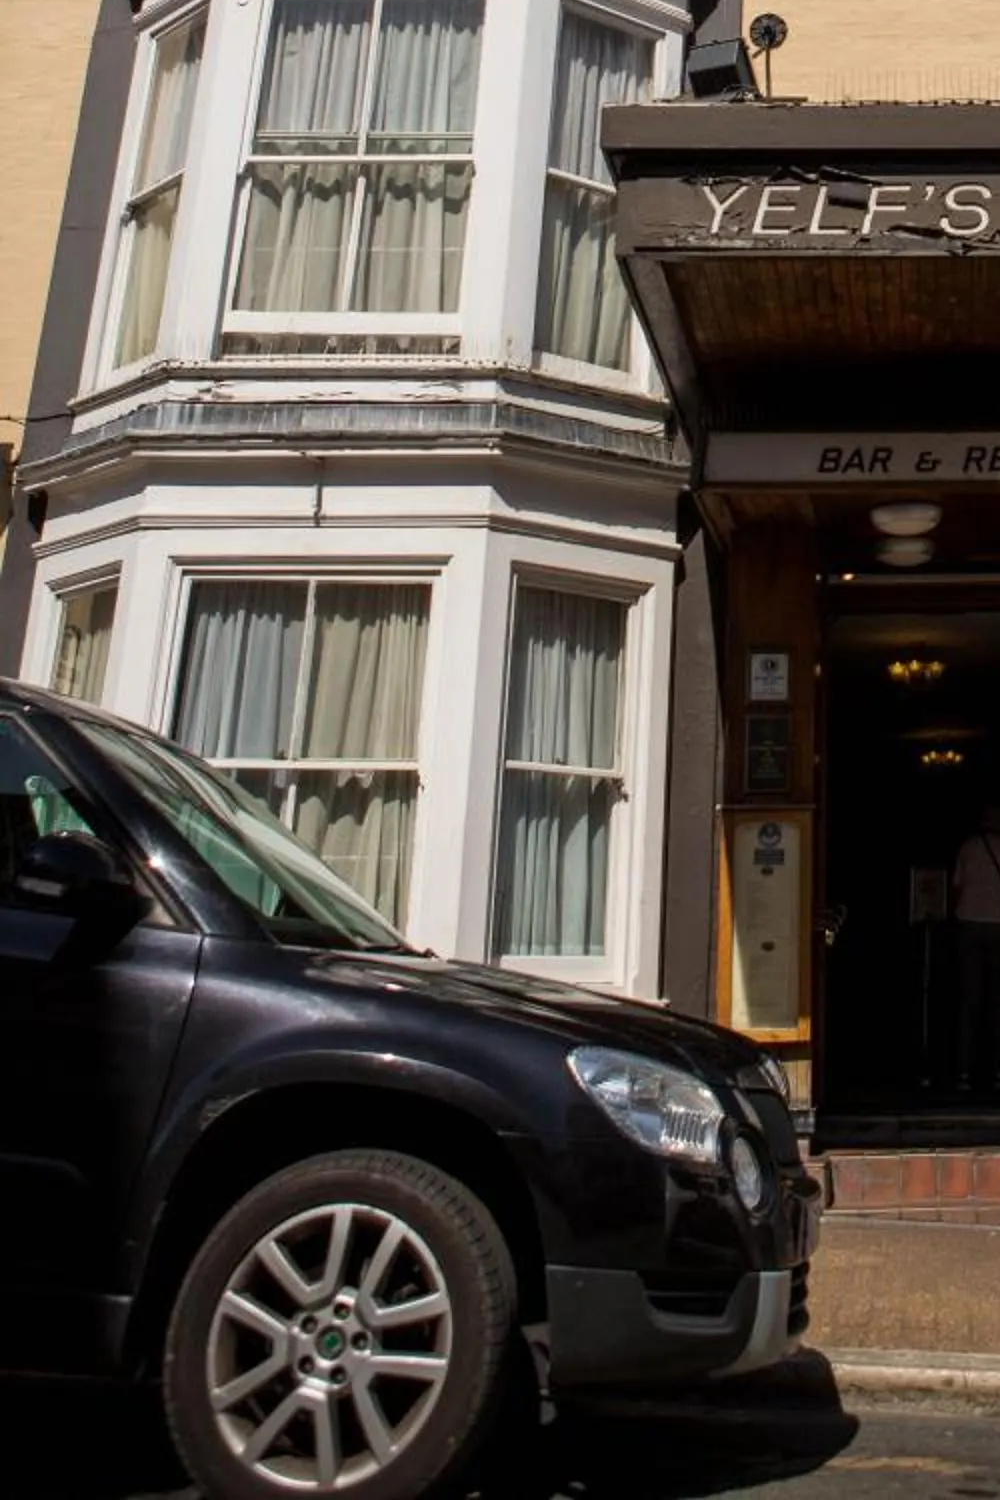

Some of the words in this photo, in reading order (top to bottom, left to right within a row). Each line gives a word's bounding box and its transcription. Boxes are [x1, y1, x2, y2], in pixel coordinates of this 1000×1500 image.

[701, 184, 993, 236] YELF'S
[816, 446, 894, 474] BAR
[914, 450, 942, 473] &
